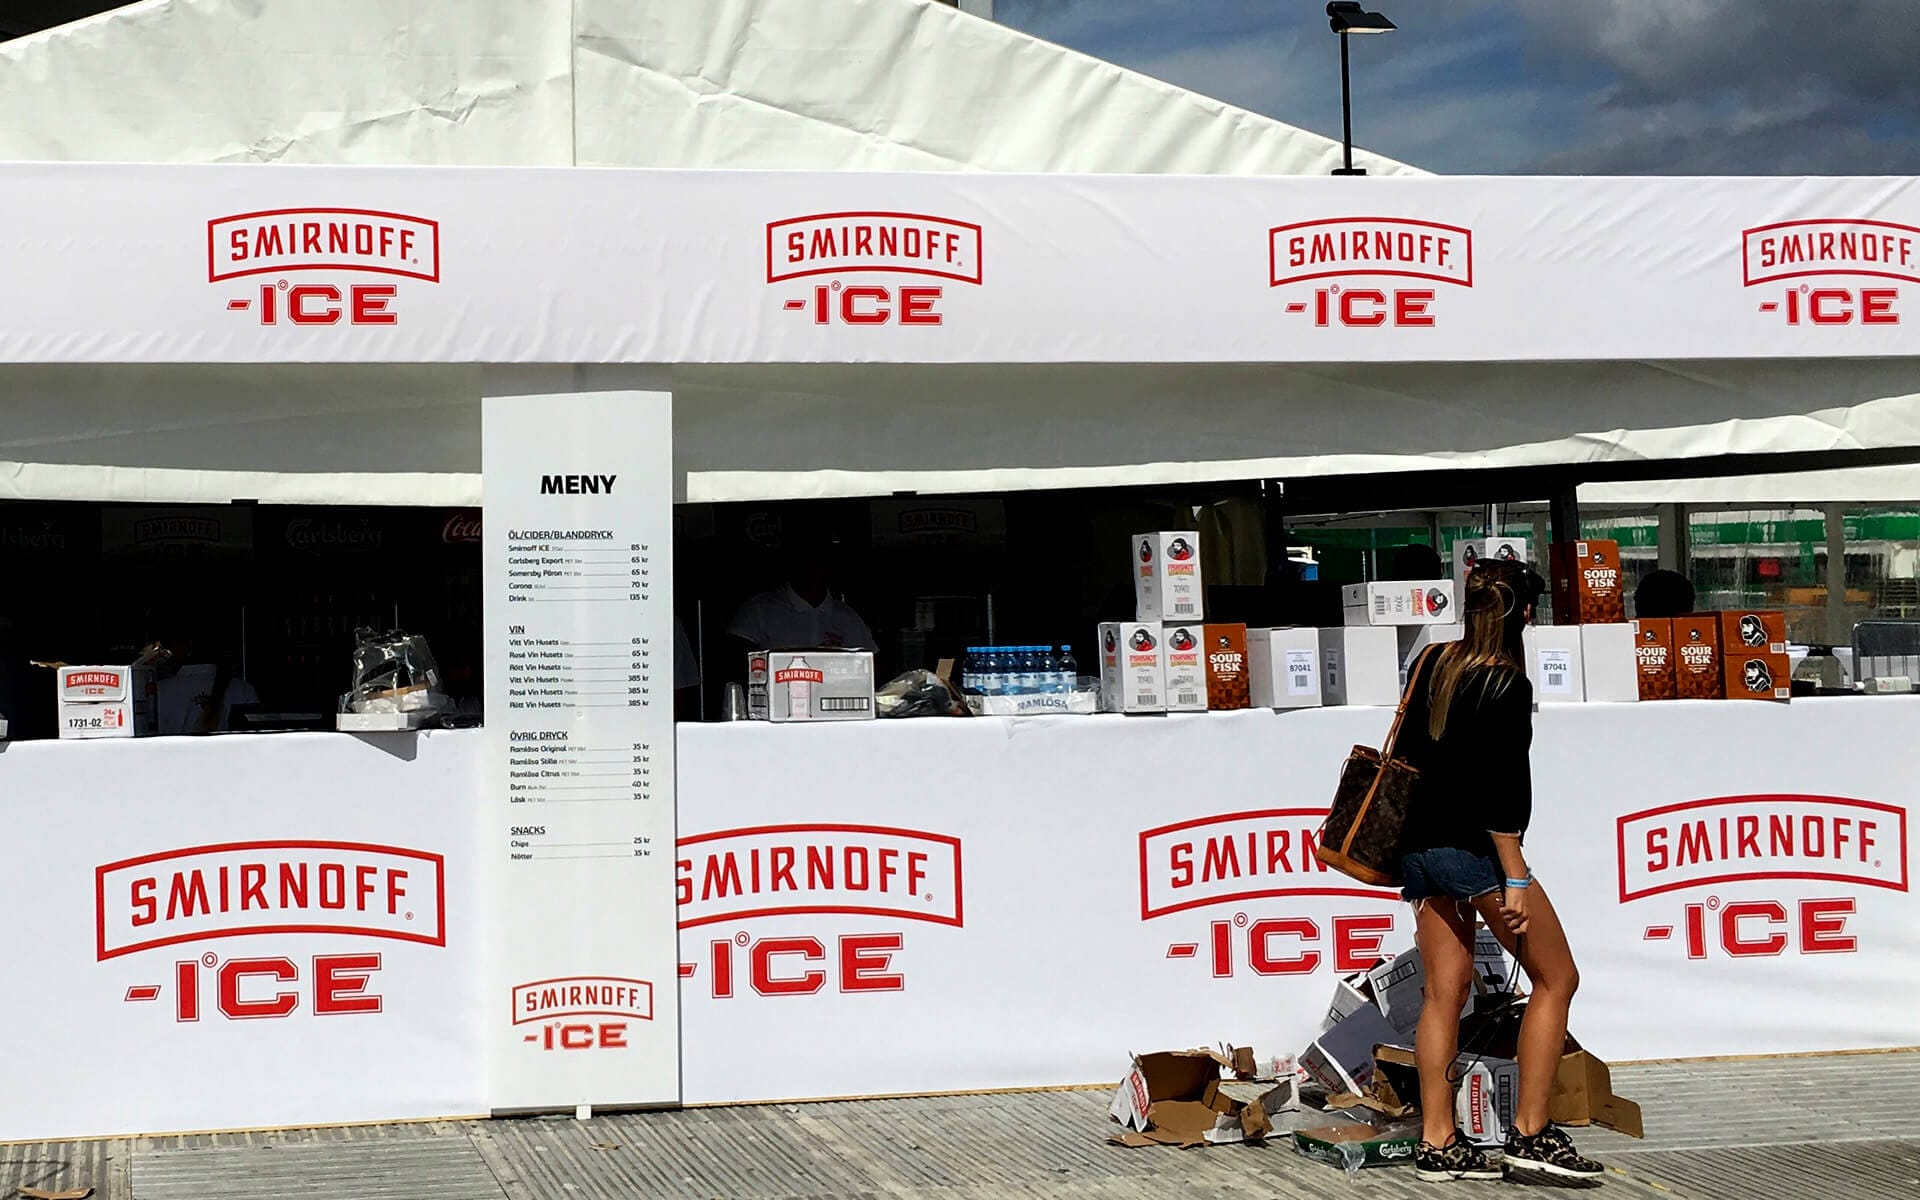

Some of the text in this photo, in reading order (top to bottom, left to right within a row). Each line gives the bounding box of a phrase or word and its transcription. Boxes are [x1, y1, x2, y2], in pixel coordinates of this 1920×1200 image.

[231, 222, 415, 261] SMIRNOFF
[788, 226, 960, 263] SMIRNOFF
[1289, 230, 1450, 268] SMIRNOFF
[1761, 231, 1912, 268] SMIRNOFF
[541, 475, 617, 494] MENY
[508, 530, 613, 540] ÖL/CIDER/BLANDDRYCK
[508, 557, 540, 565] Carlsberg
[508, 570, 541, 578] Somersby
[1584, 570, 1616, 579] SOUR
[1587, 579, 1616, 588] FISK
[509, 626, 525, 634] VIN
[1635, 647, 1667, 656] SOUR
[1680, 646, 1712, 656] SOUR
[1210, 654, 1242, 664] SOUR
[1639, 656, 1666, 665] FISK
[1684, 655, 1710, 664] FISK
[1214, 662, 1240, 672] FISK
[70, 673, 116, 685] SMIRNOFF
[778, 670, 820, 680] SMIRNOFF
[1018, 697, 1069, 711] RAMLÖSA
[68, 718, 102, 728] 1731-02
[510, 730, 568, 740] ÖVRIG DRYCK
[540, 745, 566, 754] Original
[511, 826, 546, 836] SNACKS
[1646, 814, 1877, 873] SMIRNOFF
[1169, 829, 1328, 888] SMIRN
[131, 862, 410, 927] SMIRNOFF
[526, 986, 637, 1012] SMIRNOFF
[1471, 1080, 1481, 1130] SMIRNOFF
[1379, 1141, 1412, 1158] Carlsberg
